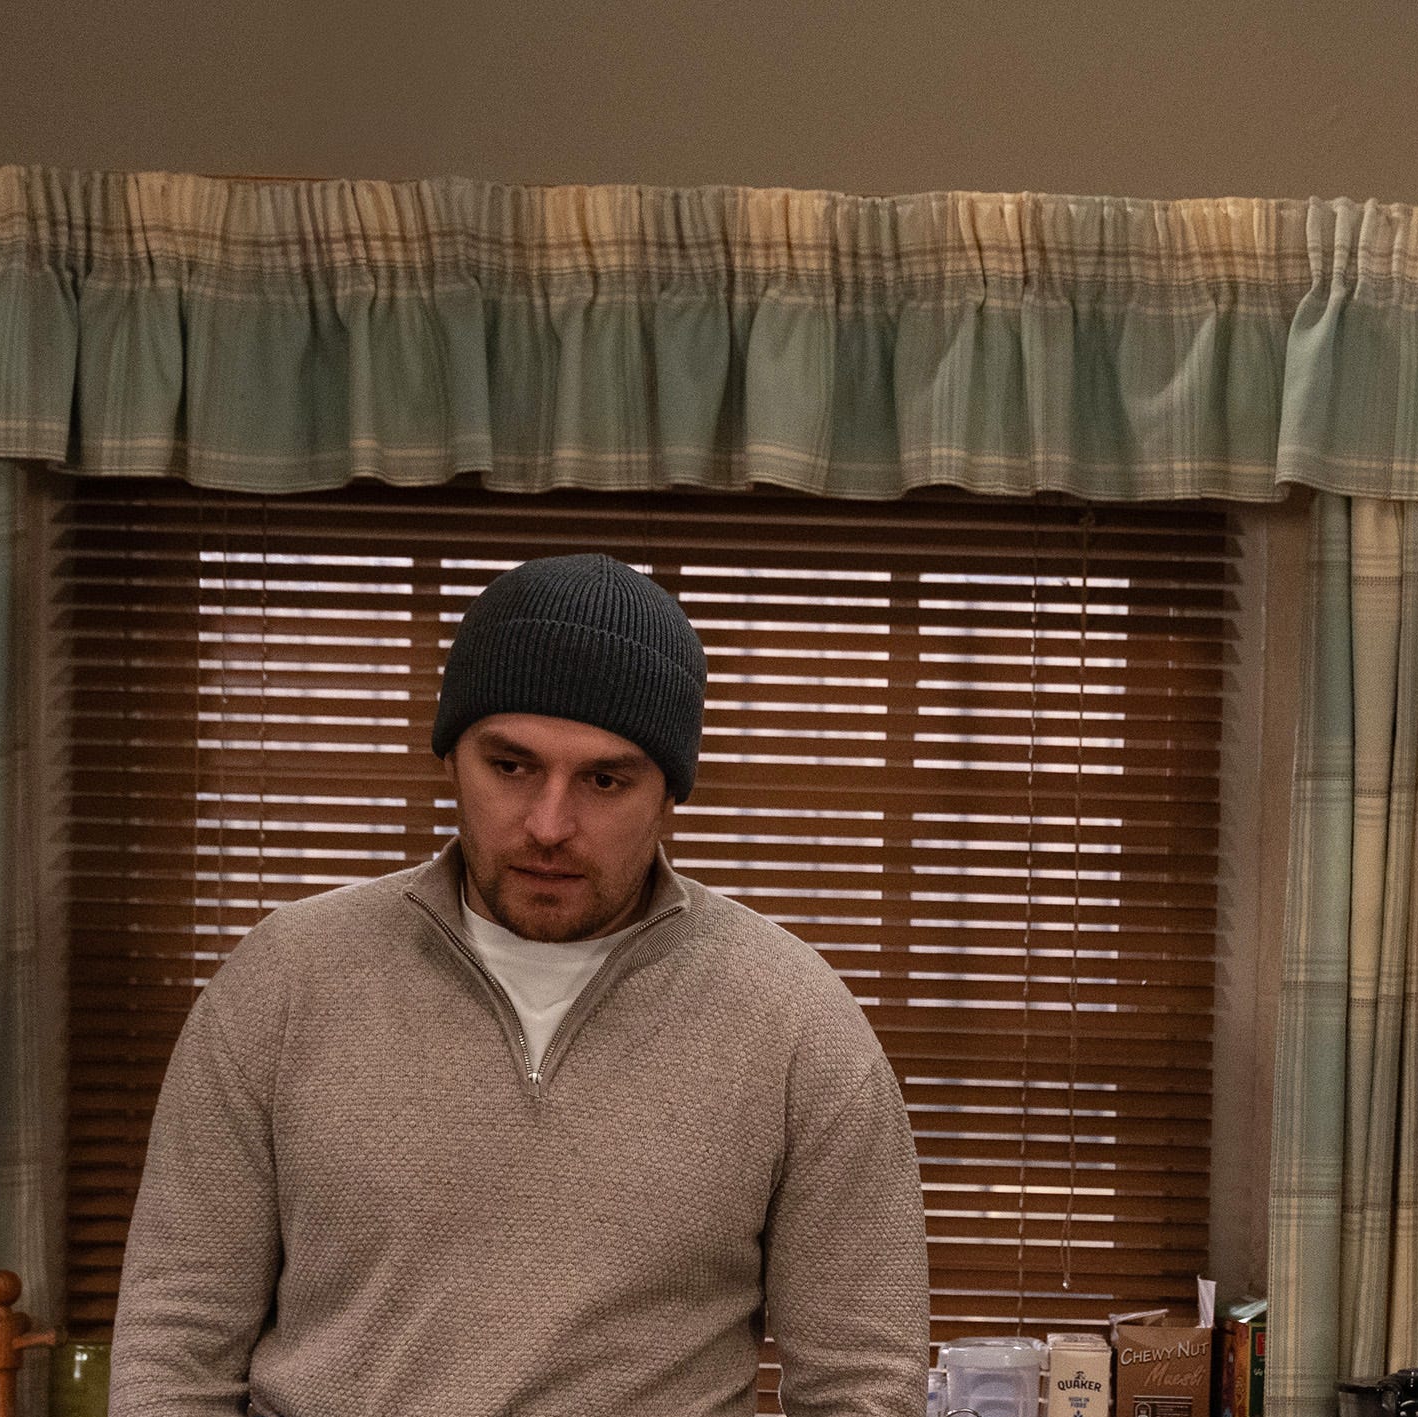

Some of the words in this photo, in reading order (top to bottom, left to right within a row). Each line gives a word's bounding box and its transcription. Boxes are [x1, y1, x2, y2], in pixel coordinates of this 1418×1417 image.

[1120, 1346, 1175, 1366] CHEWY
[1177, 1340, 1210, 1358] NUT
[1057, 1379, 1102, 1393] QUAKER
[1143, 1362, 1206, 1387] Muesli
